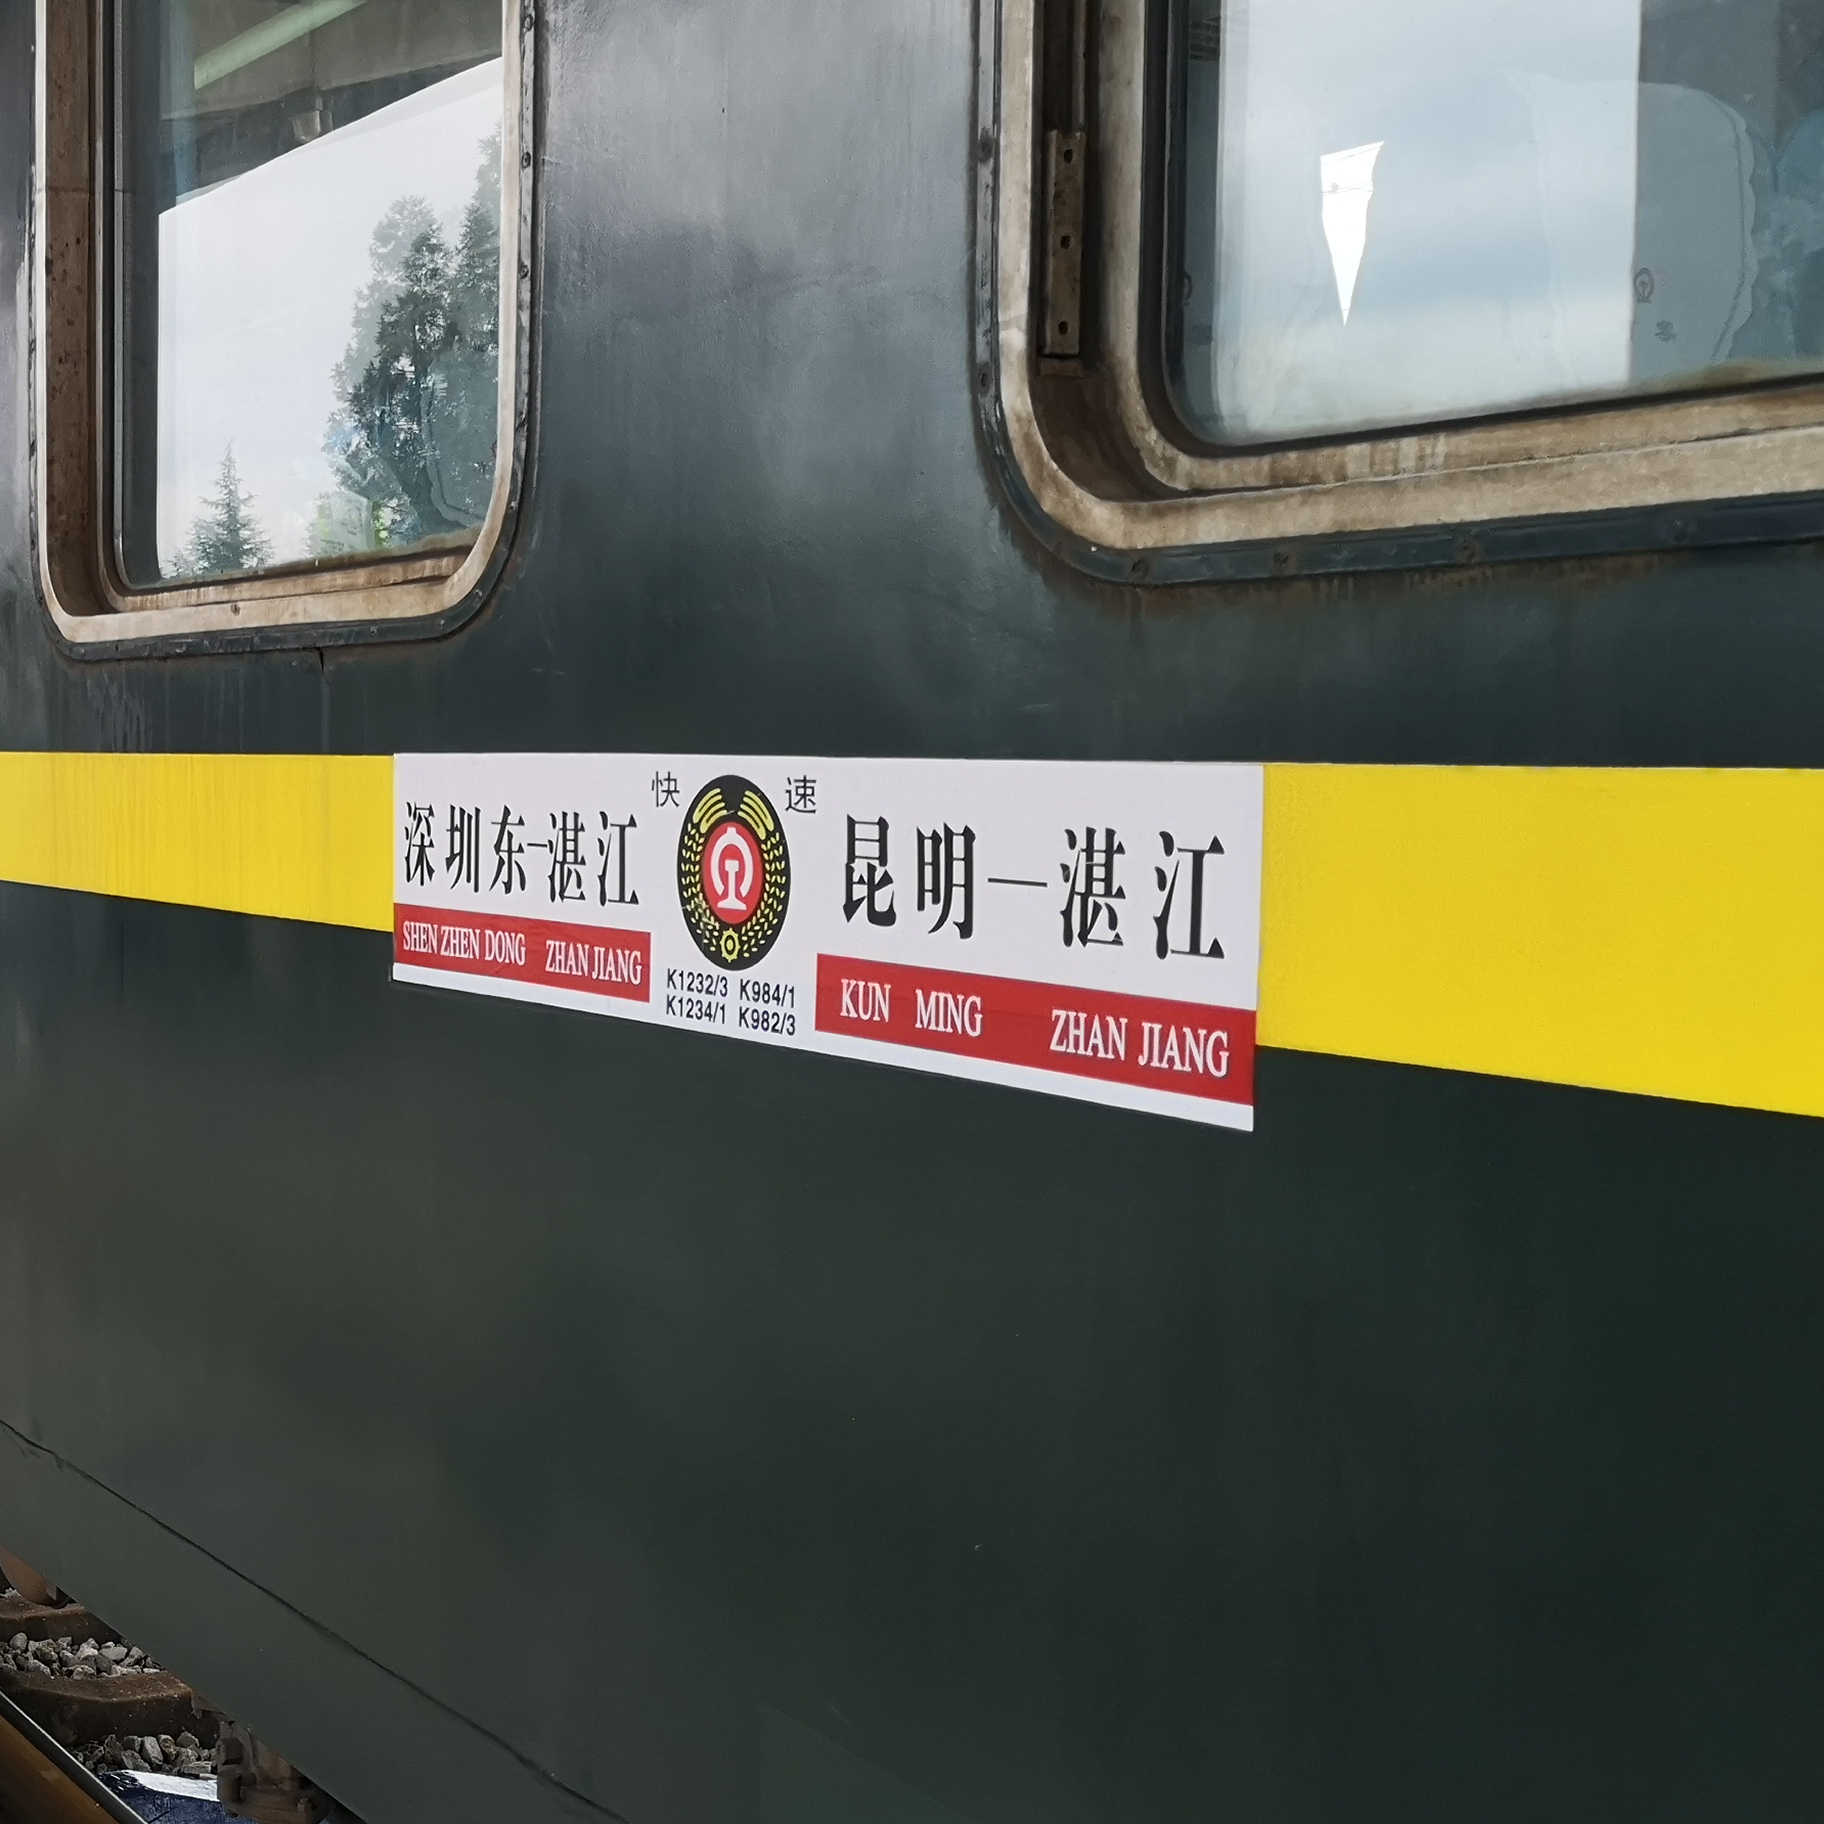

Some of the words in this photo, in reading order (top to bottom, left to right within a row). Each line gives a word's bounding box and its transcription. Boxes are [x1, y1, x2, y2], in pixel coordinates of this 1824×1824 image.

[403, 920, 439, 953] SHEN
[440, 925, 480, 960] ZHEN
[484, 930, 526, 966] DONG
[545, 939, 589, 977] ZHAN
[591, 946, 643, 985] JIANG
[667, 968, 728, 997] K1232/3
[739, 978, 796, 1008] K984/1
[666, 994, 726, 1025] K1234/1
[738, 1006, 796, 1036] K982/3
[839, 978, 891, 1023] KUN
[914, 989, 984, 1038] MING
[1049, 1008, 1128, 1061] ZHAN
[1138, 1021, 1230, 1078] JIANG
